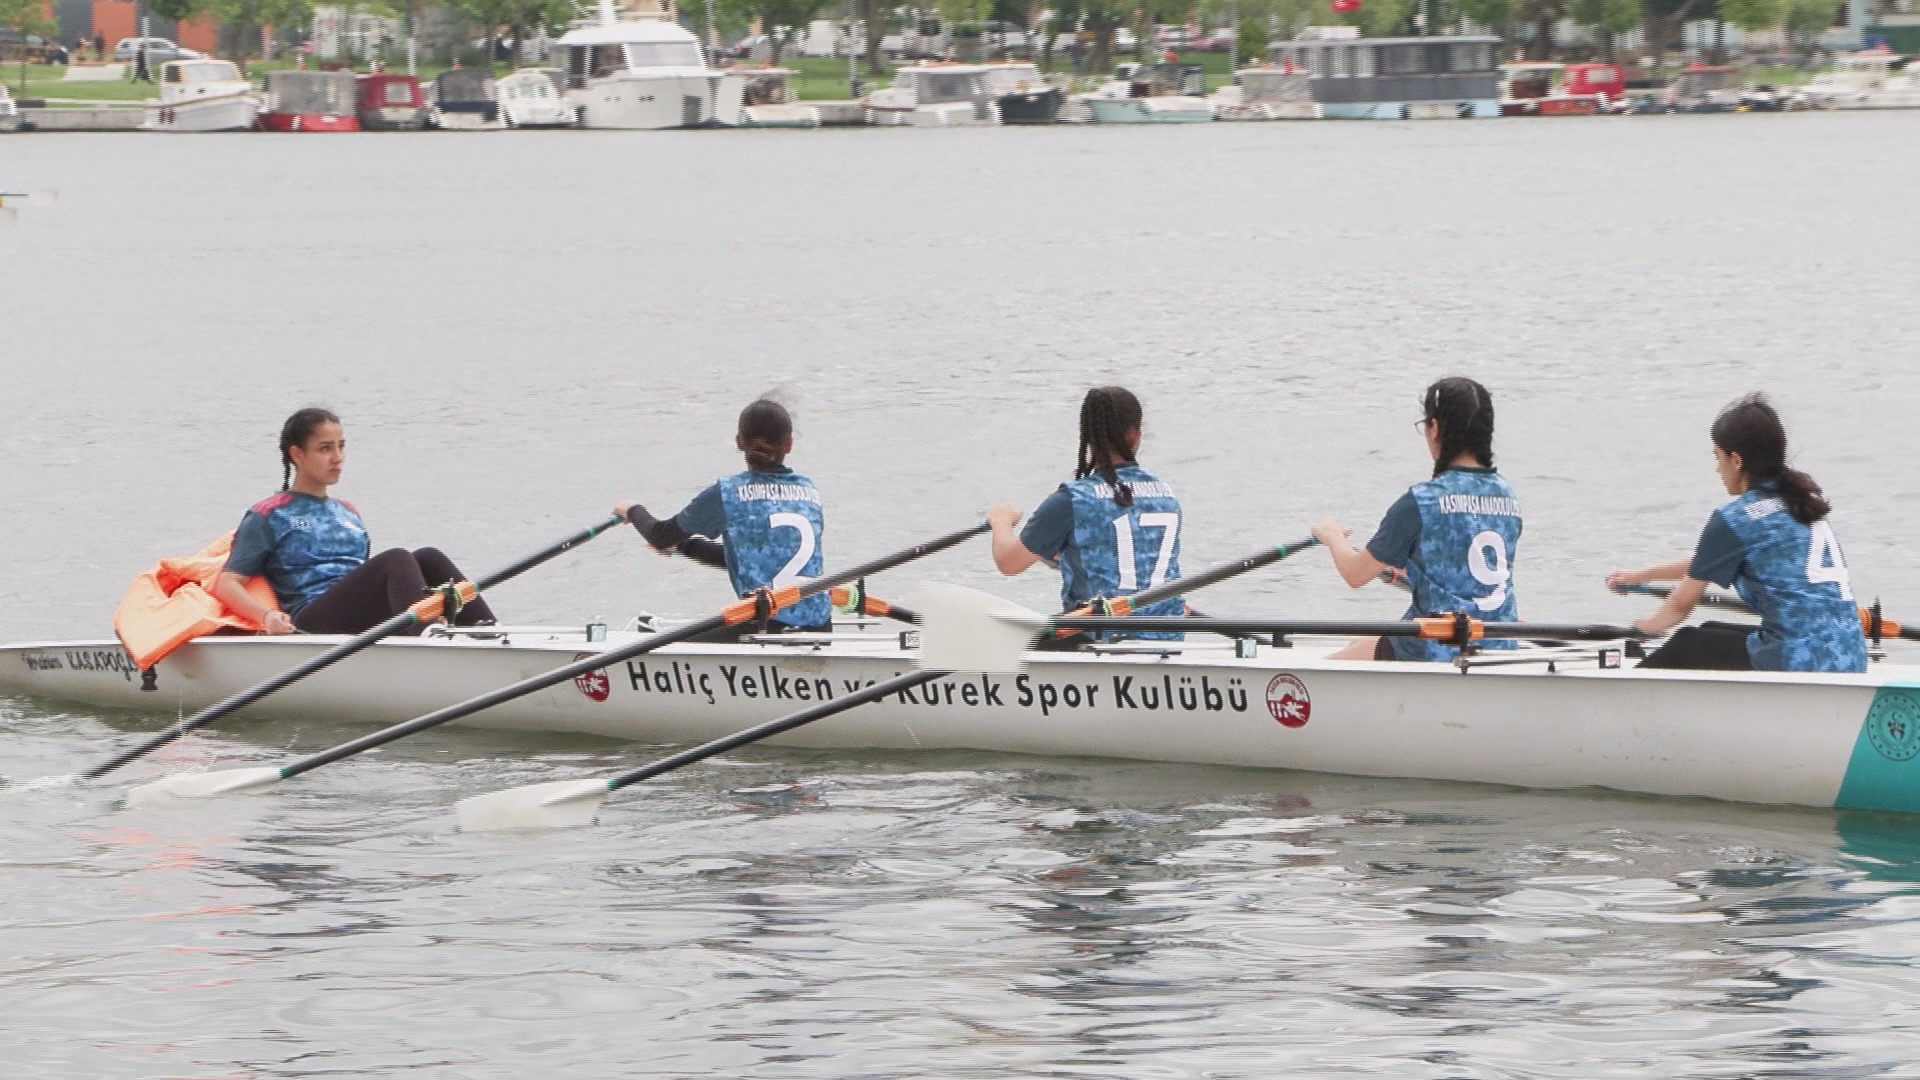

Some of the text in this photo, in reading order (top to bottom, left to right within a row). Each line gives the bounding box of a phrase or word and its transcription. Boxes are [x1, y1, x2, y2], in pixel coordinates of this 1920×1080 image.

[769, 512, 821, 590] 2
[1112, 512, 1179, 590] 17
[1468, 530, 1510, 611] 9
[1805, 520, 1854, 601] 4
[627, 661, 715, 705] Haliç
[719, 665, 833, 701] Yelken
[1015, 673, 1099, 716] Spor
[1113, 675, 1248, 712] Kulübü
